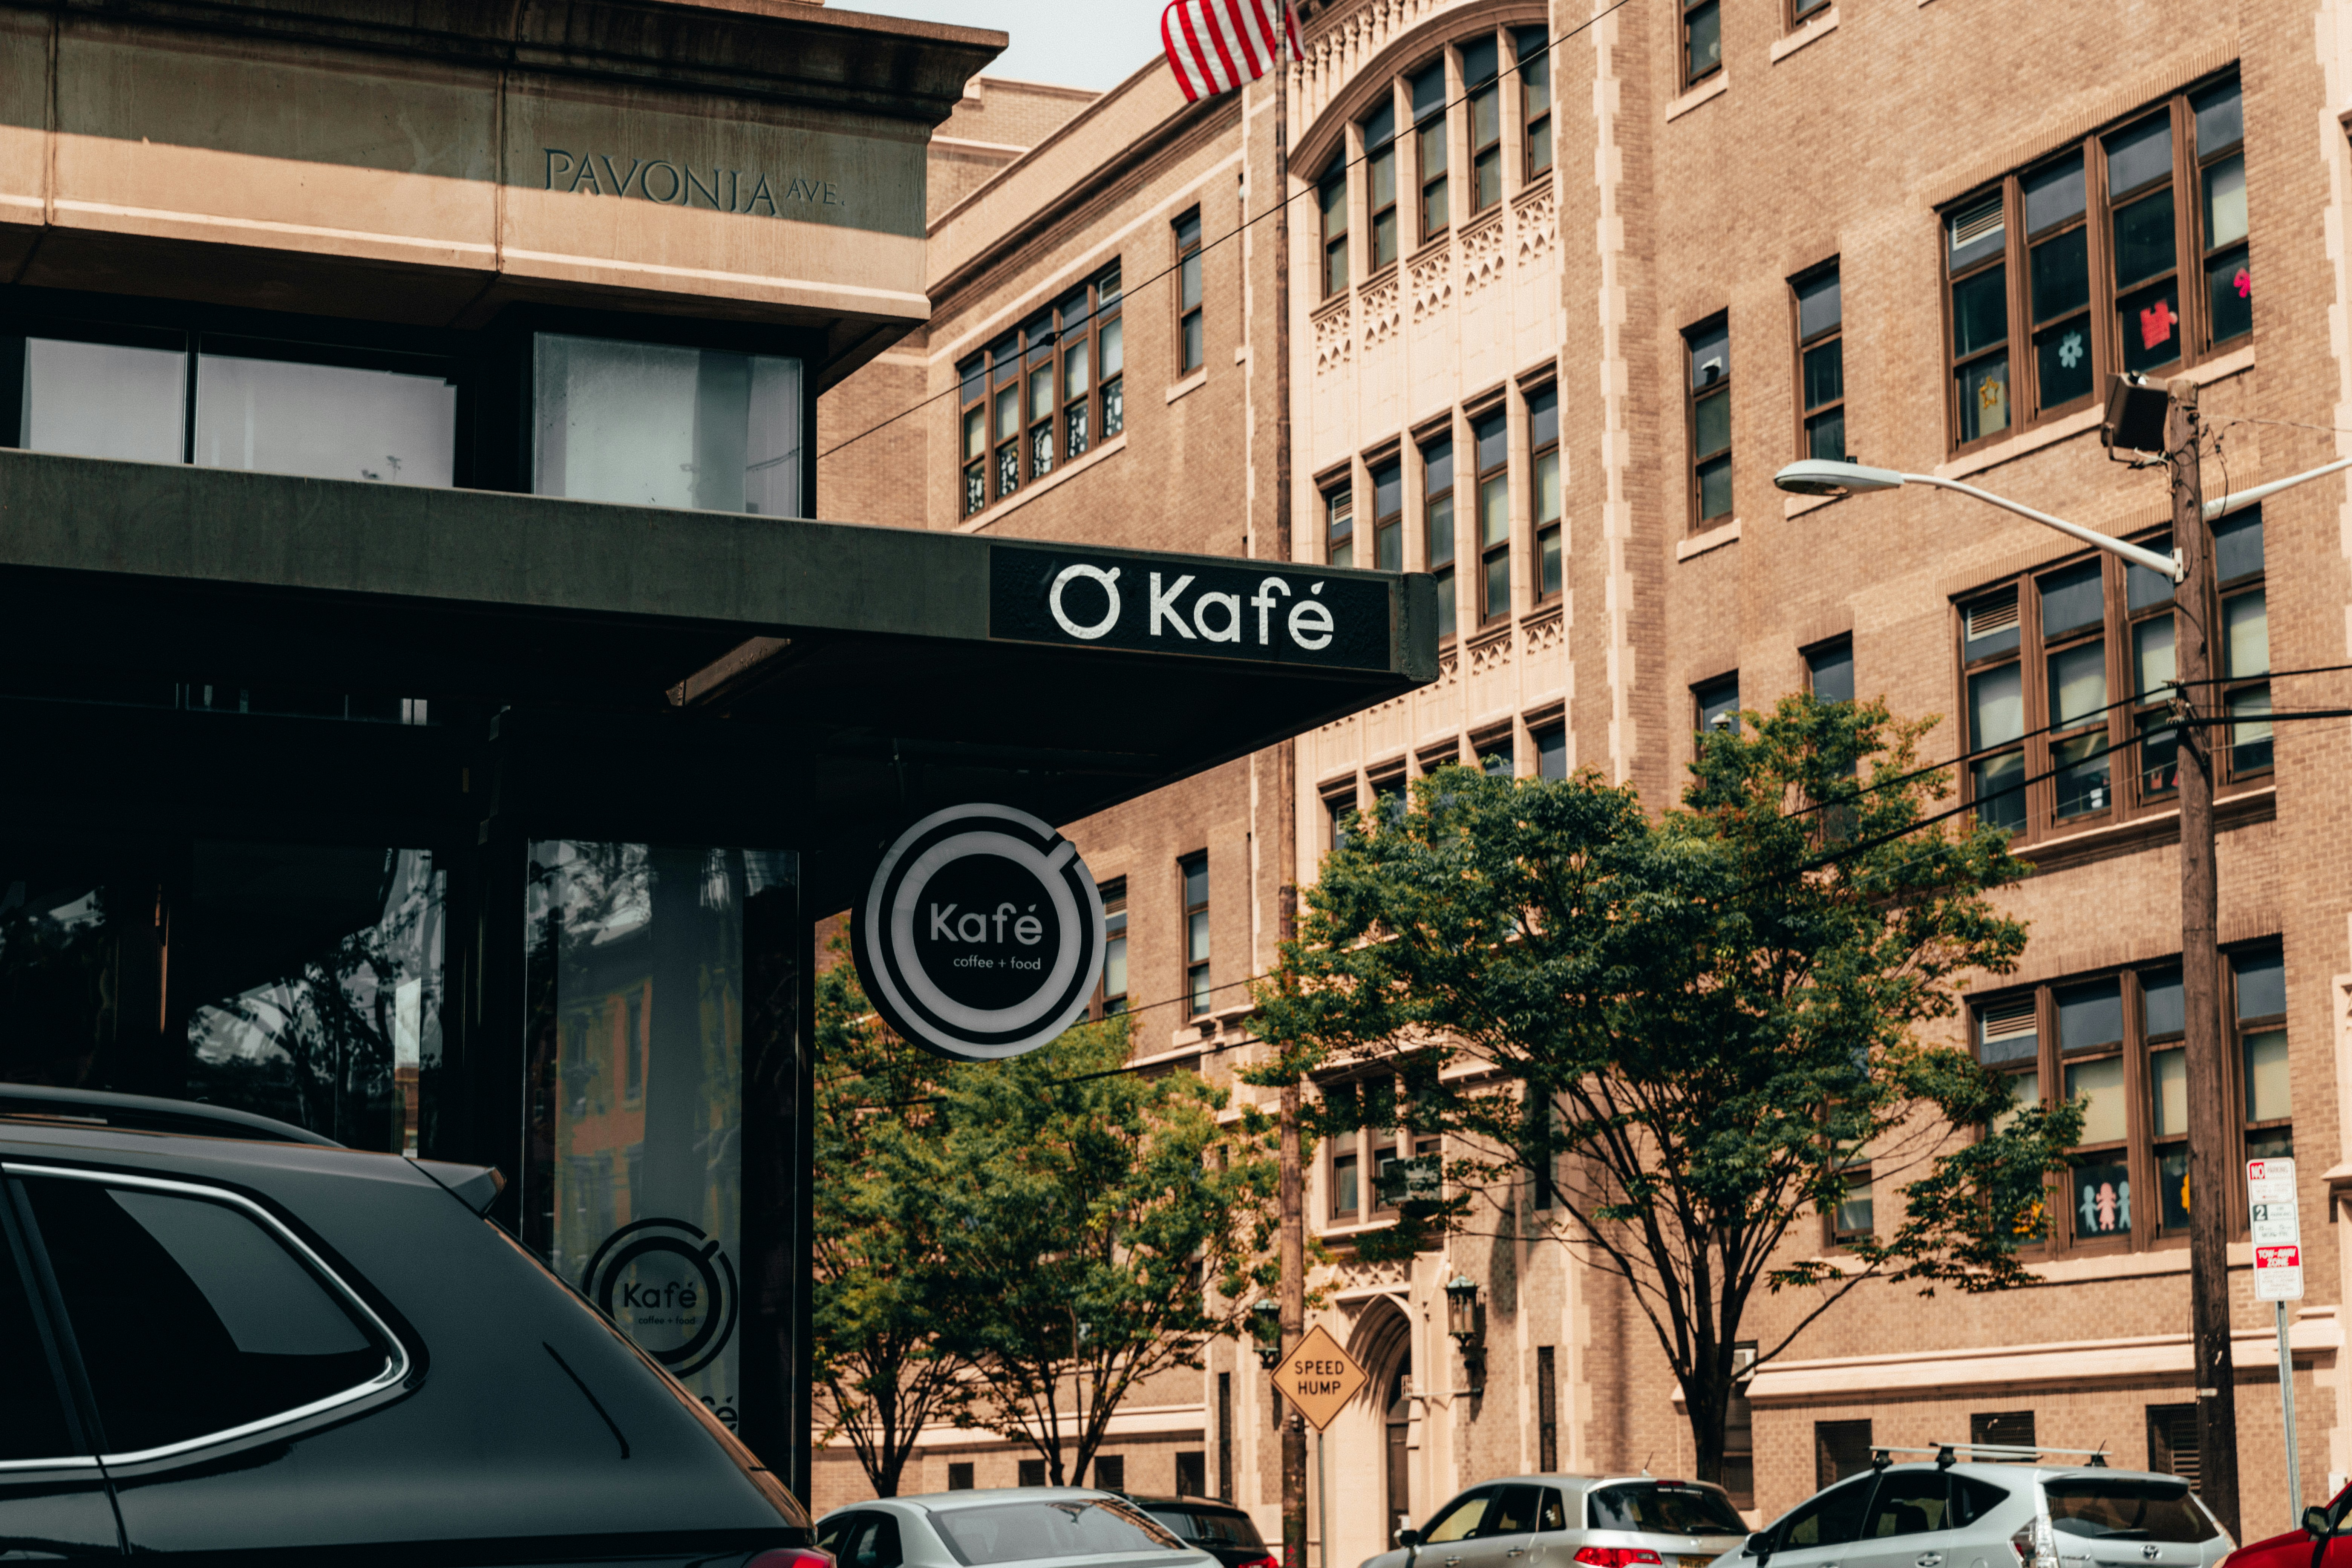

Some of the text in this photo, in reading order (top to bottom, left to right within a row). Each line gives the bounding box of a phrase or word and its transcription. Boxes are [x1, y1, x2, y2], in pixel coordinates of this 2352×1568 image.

[544, 148, 845, 217] PAVONIA AVE.
[1150, 571, 1334, 651] Kafé
[931, 902, 1043, 945] Kafé
[953, 954, 994, 968] coffee
[1011, 956, 1041, 970] food
[2251, 1164, 2265, 1180] NO
[2256, 1205, 2266, 1220] 2
[2267, 1257, 2289, 1267] ZONE
[624, 1282, 697, 1308] Kafé
[638, 1315, 665, 1325] coffee
[676, 1316, 695, 1325] food
[1295, 1360, 1344, 1375] SPEED
[1298, 1381, 1341, 1395] HUMP
